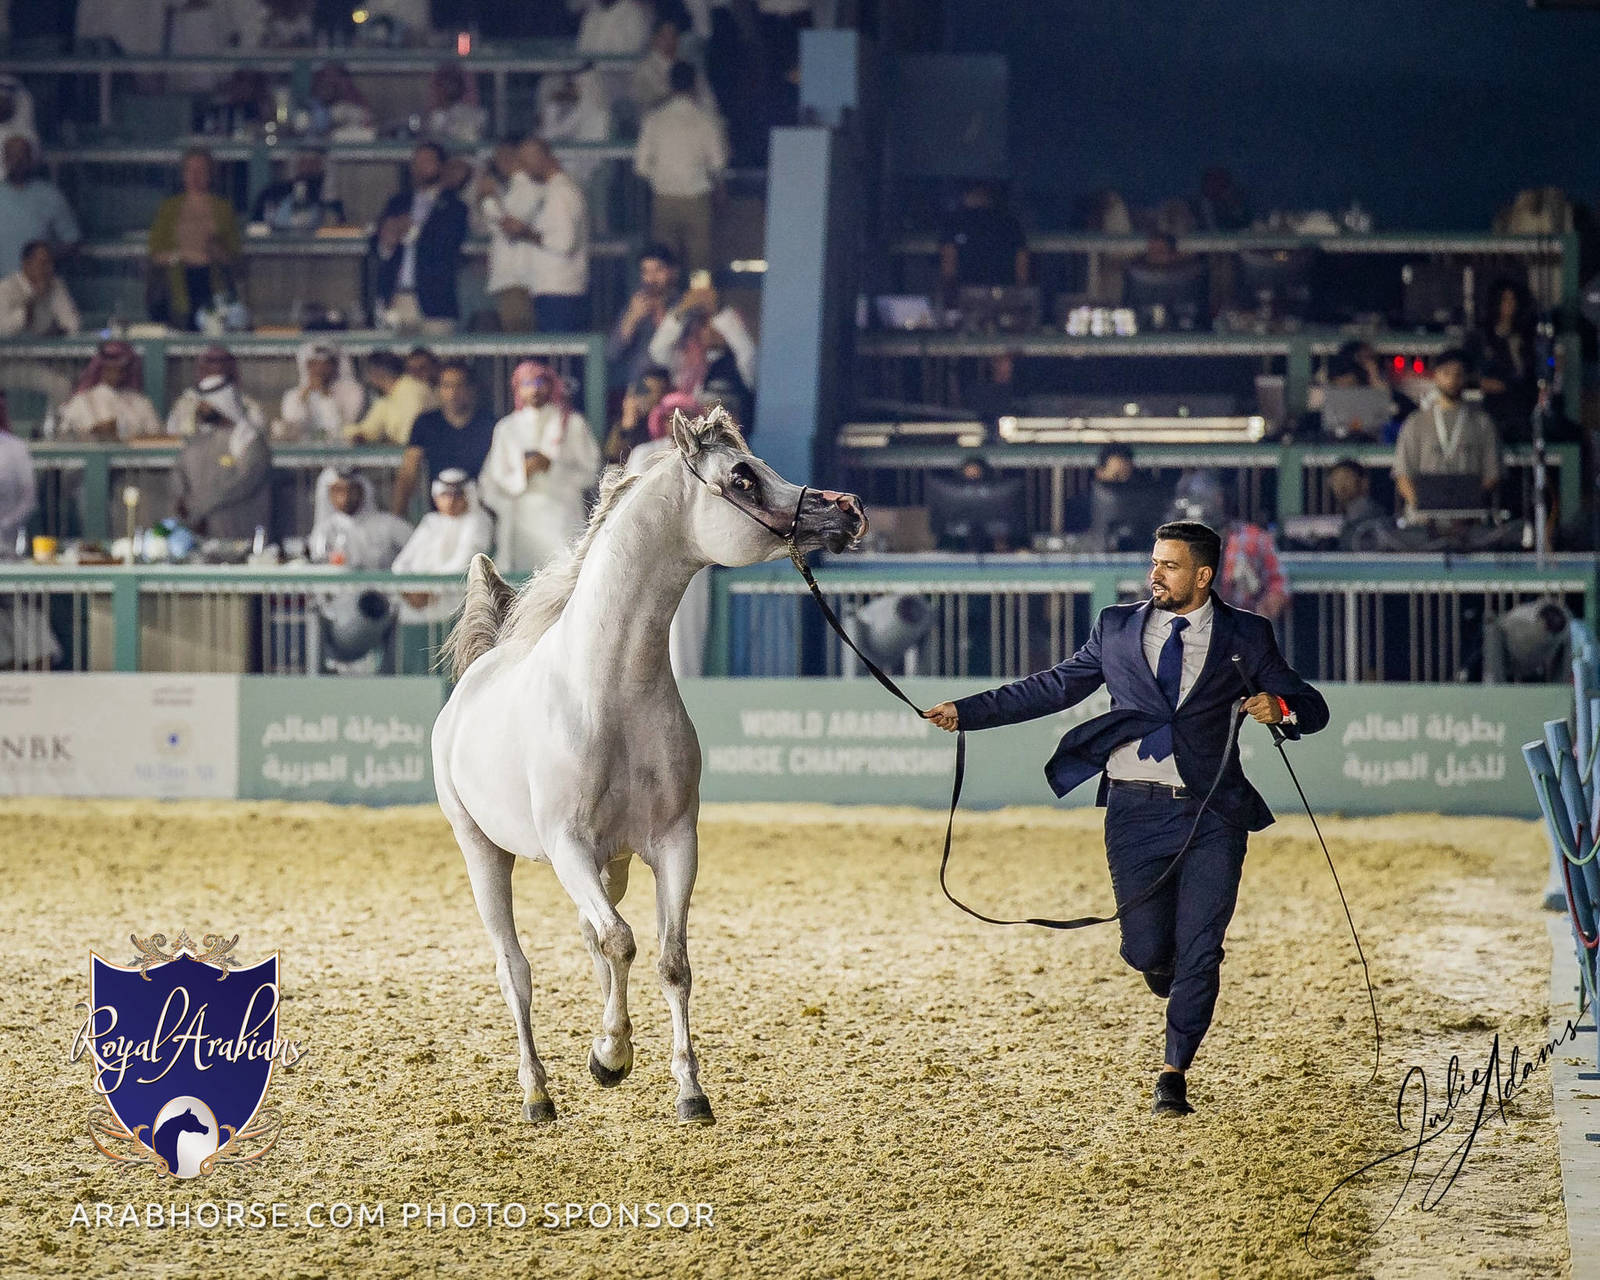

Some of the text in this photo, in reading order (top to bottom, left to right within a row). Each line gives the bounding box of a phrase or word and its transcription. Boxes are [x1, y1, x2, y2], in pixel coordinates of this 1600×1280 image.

[262, 715, 424, 748] بطولة العالم
[741, 711, 927, 737] WORLD ARABIAN
[1342, 712, 1506, 746] بطولة العالم
[708, 746, 783, 774] HORSE
